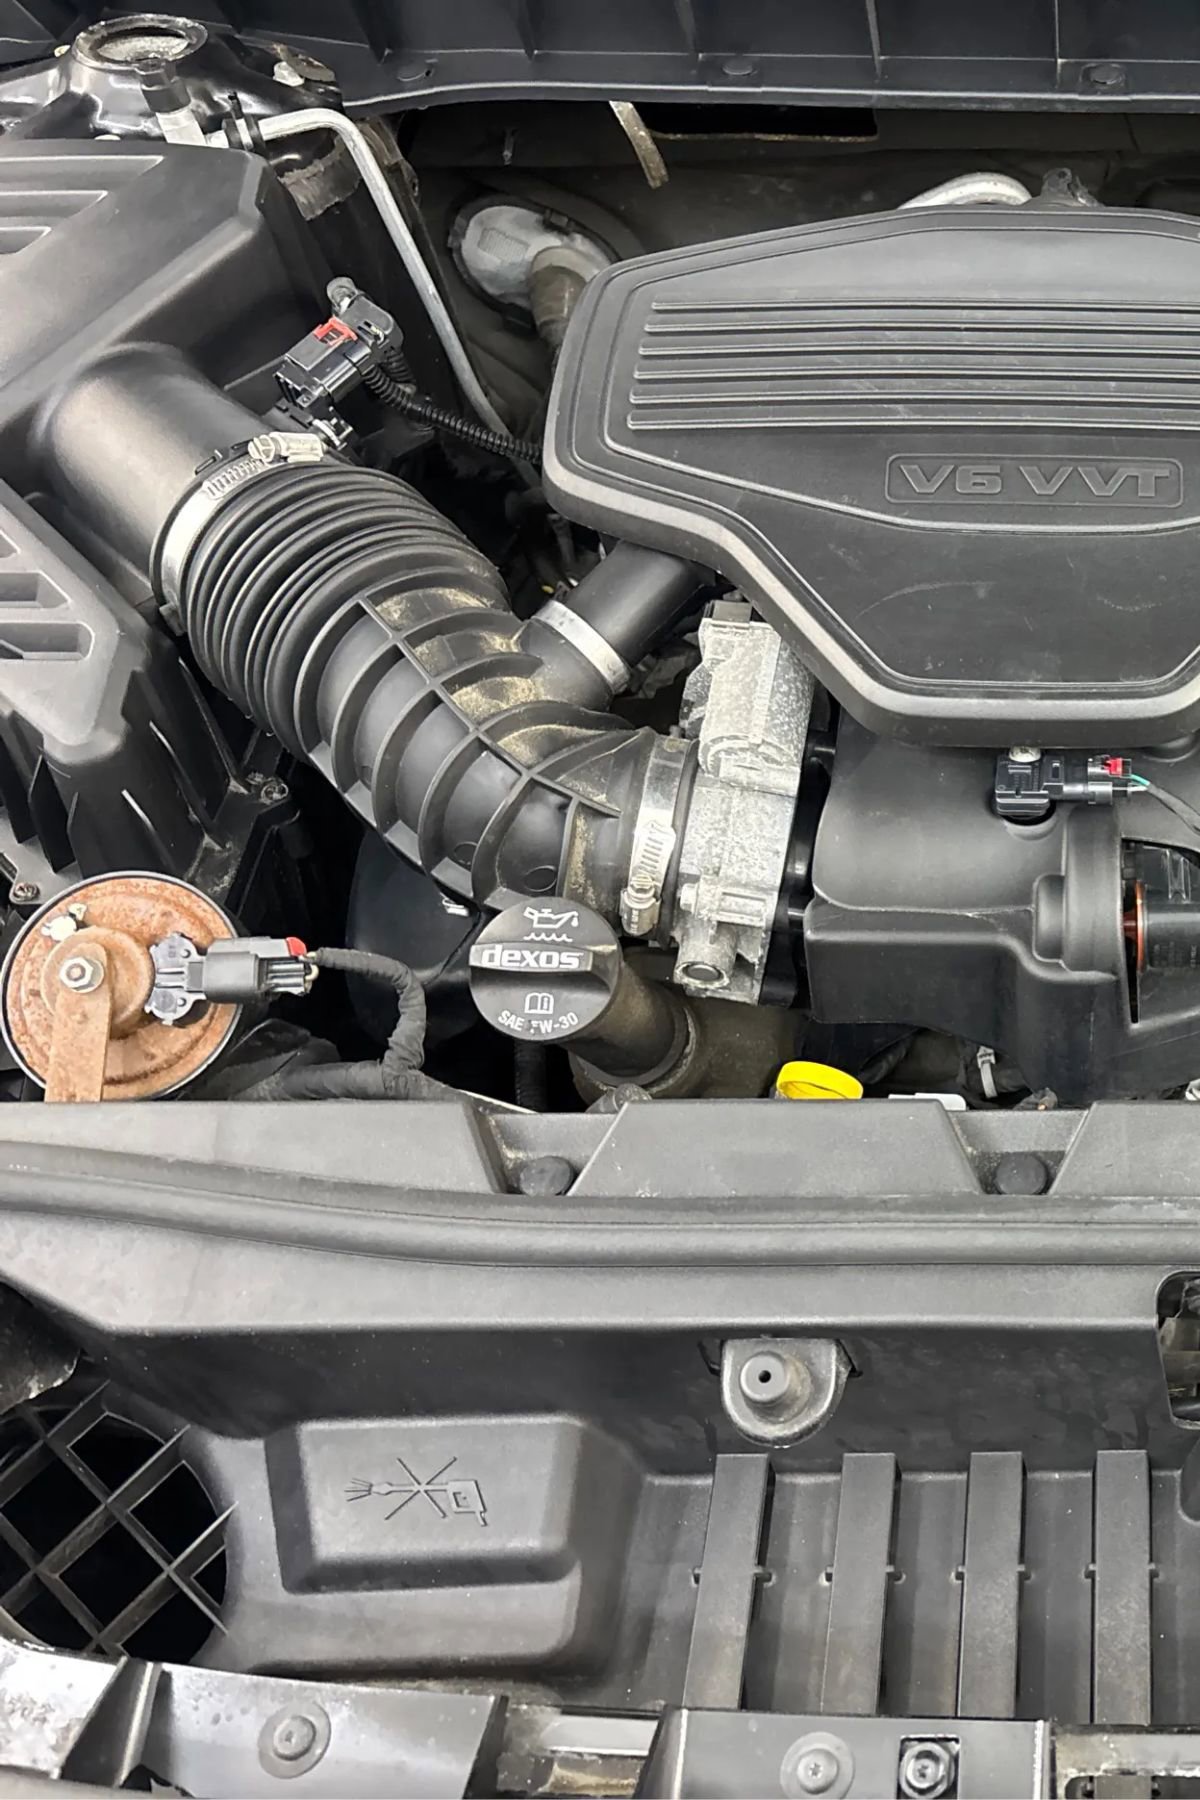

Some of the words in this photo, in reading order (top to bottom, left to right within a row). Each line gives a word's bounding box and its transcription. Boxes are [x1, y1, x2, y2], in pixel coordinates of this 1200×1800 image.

[899, 464, 1003, 494] V6
[1018, 465, 1171, 498] VVT
[481, 944, 584, 969] dexos
[498, 1010, 525, 1032] SAE
